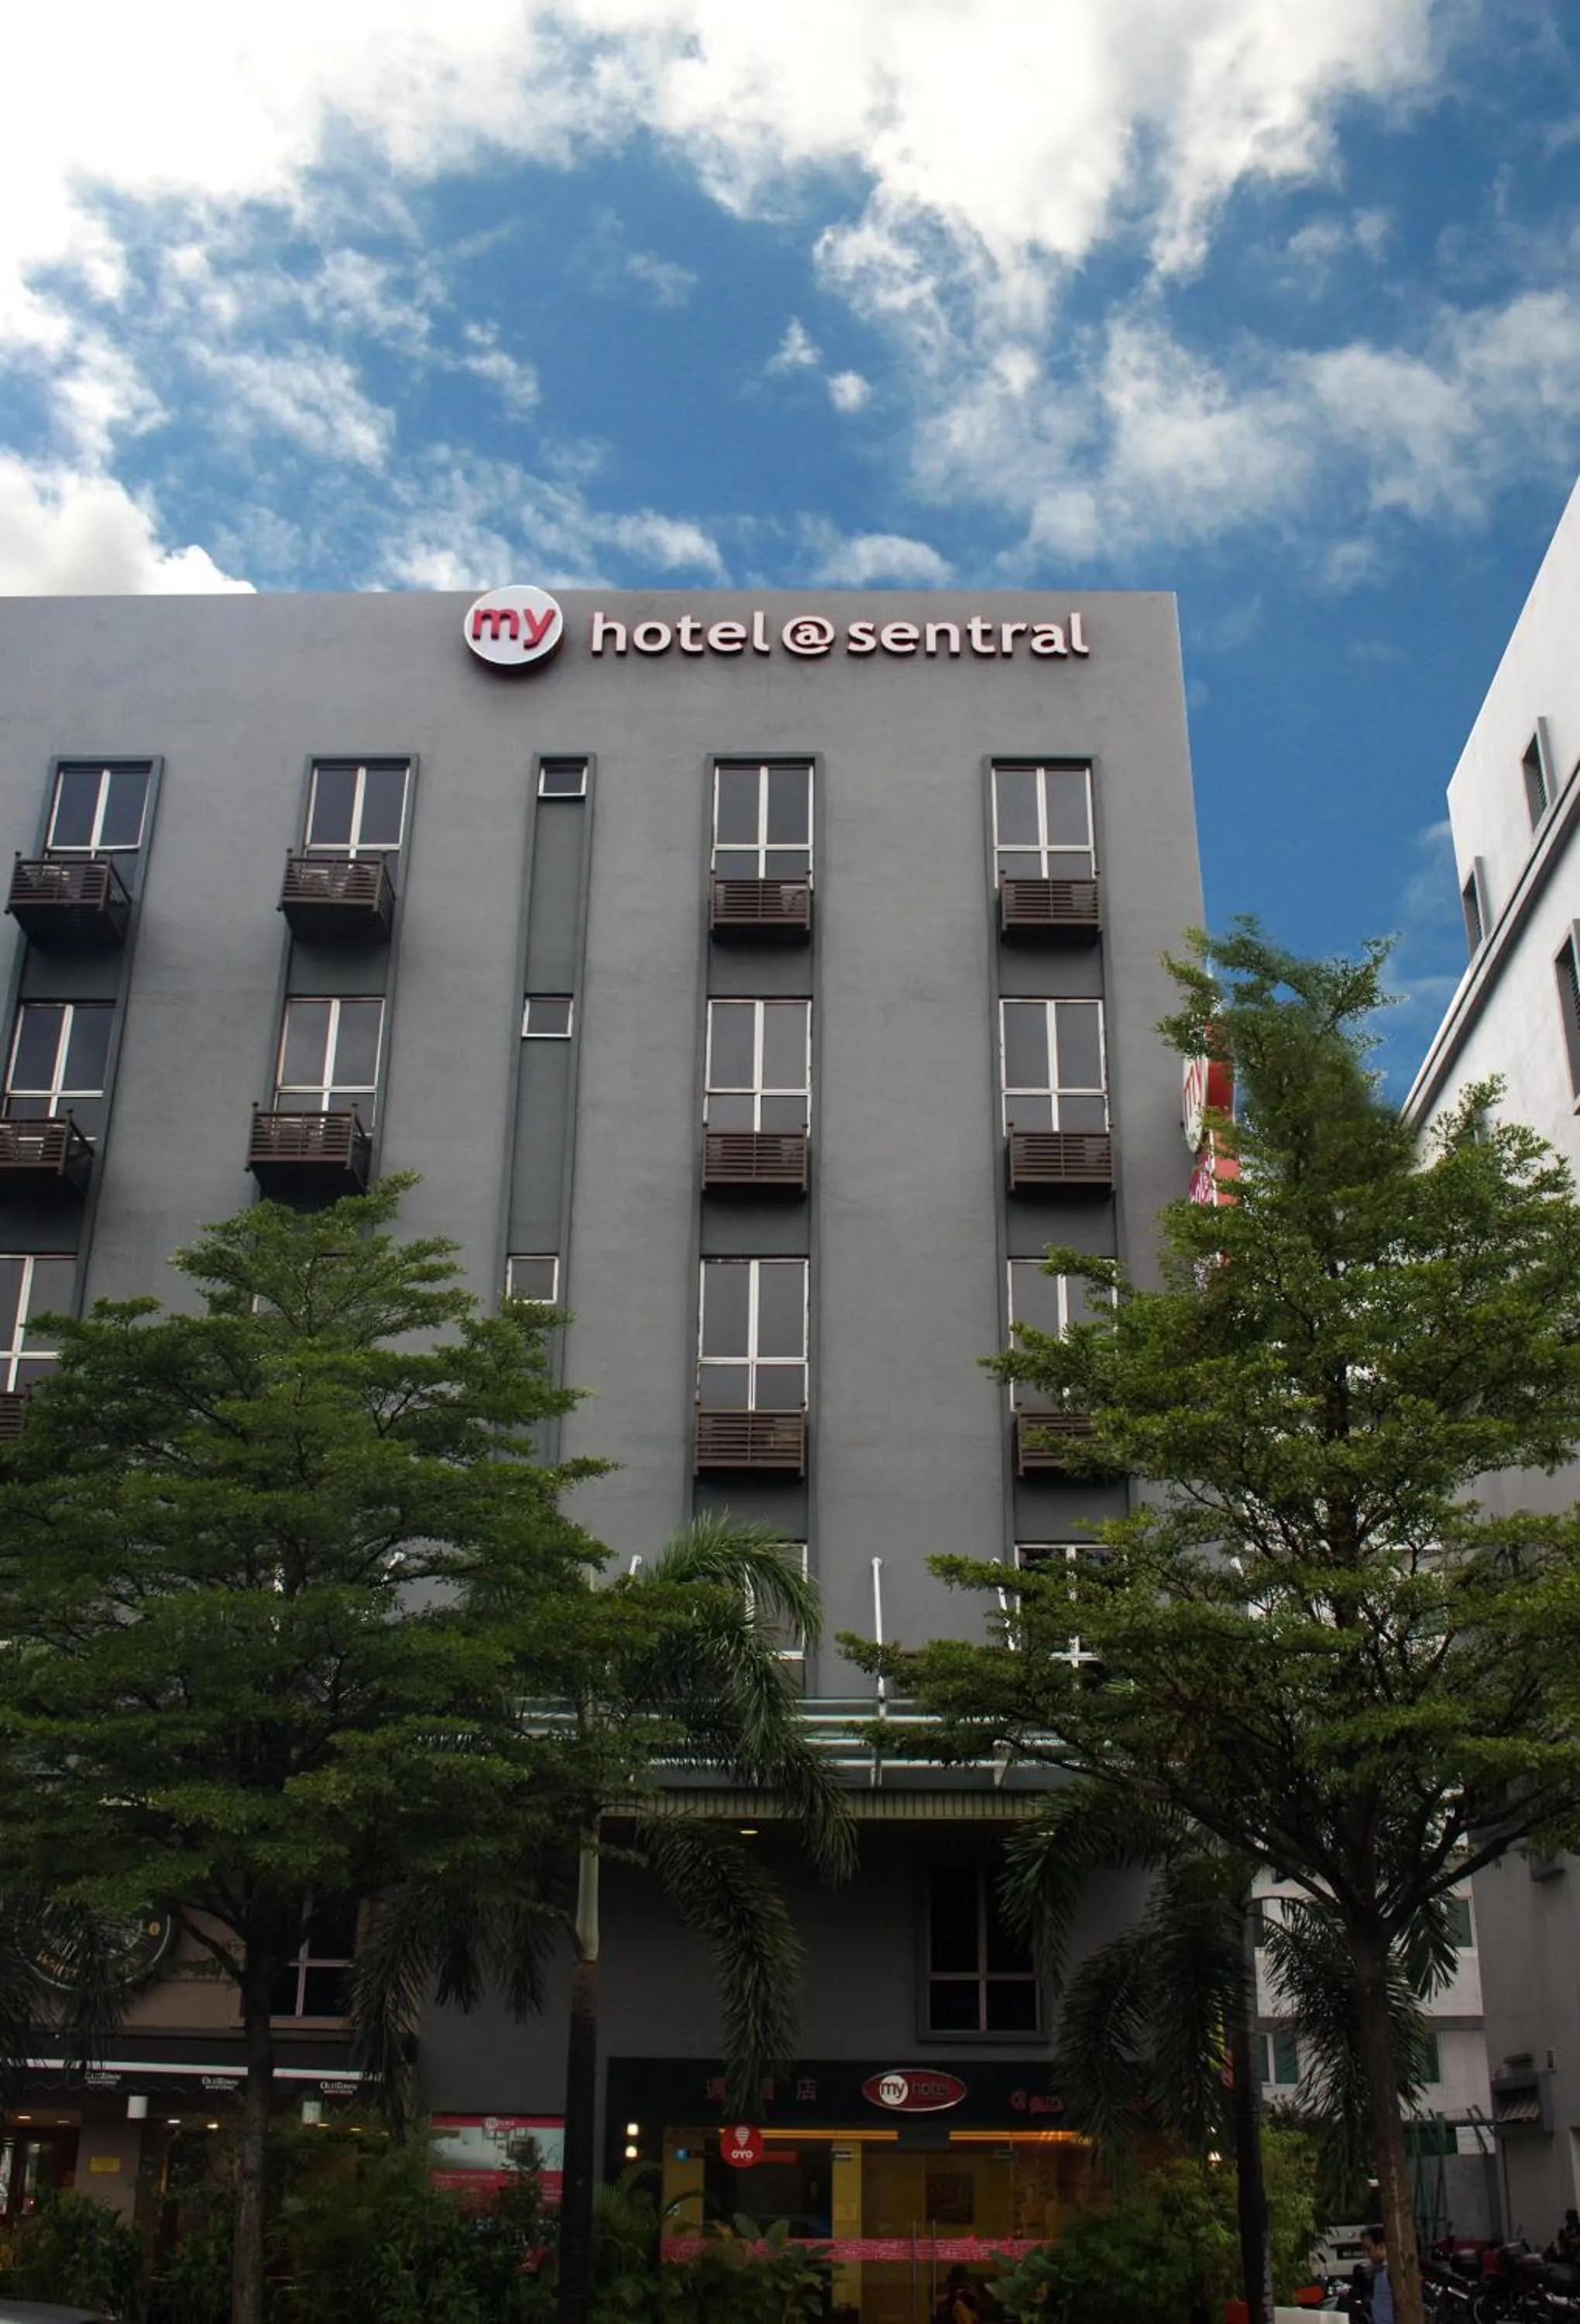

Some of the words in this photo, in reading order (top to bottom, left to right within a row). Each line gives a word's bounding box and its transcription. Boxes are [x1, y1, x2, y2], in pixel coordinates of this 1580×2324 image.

[472, 608, 556, 649] my
[881, 2082, 905, 2098] my
[731, 2149, 754, 2159] OYO
